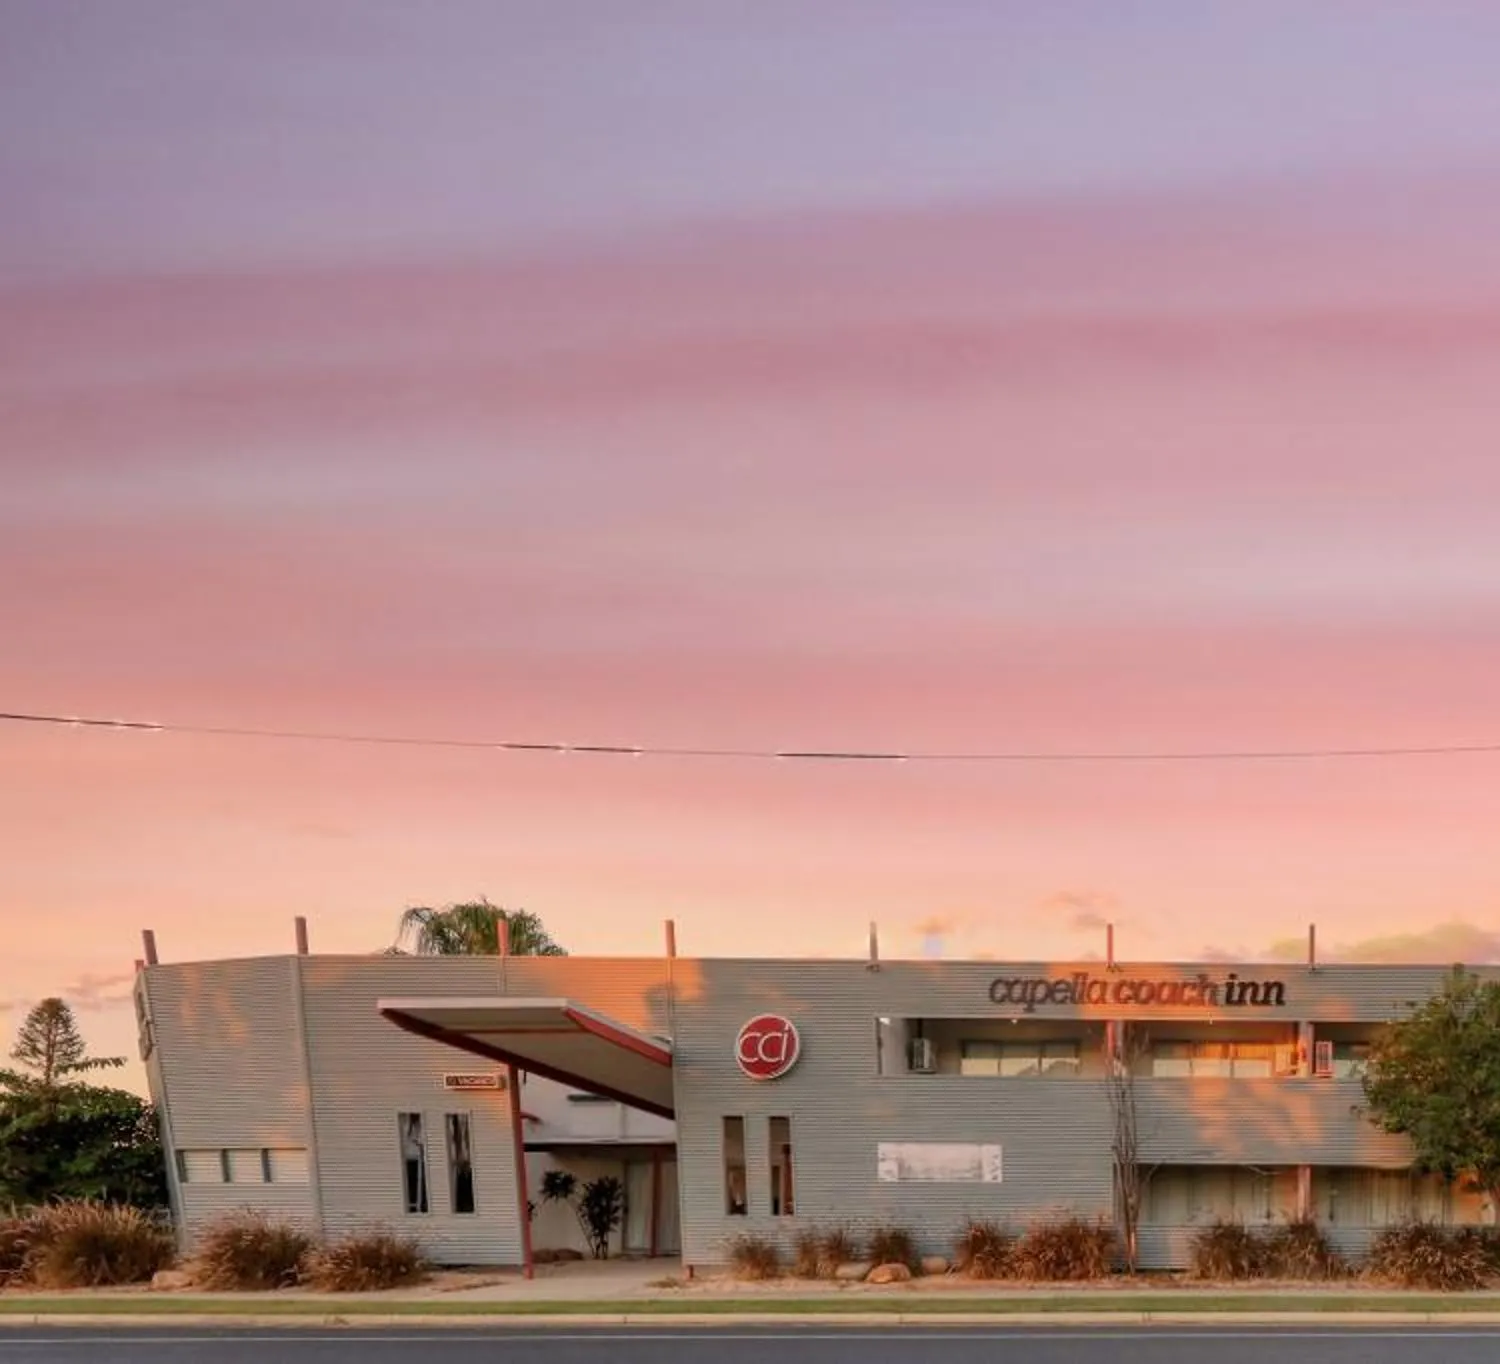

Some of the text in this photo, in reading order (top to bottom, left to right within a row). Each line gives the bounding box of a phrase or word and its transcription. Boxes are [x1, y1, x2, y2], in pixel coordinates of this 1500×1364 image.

[988, 972, 1286, 1013] capella coach inn
[739, 1023, 790, 1063] cci
